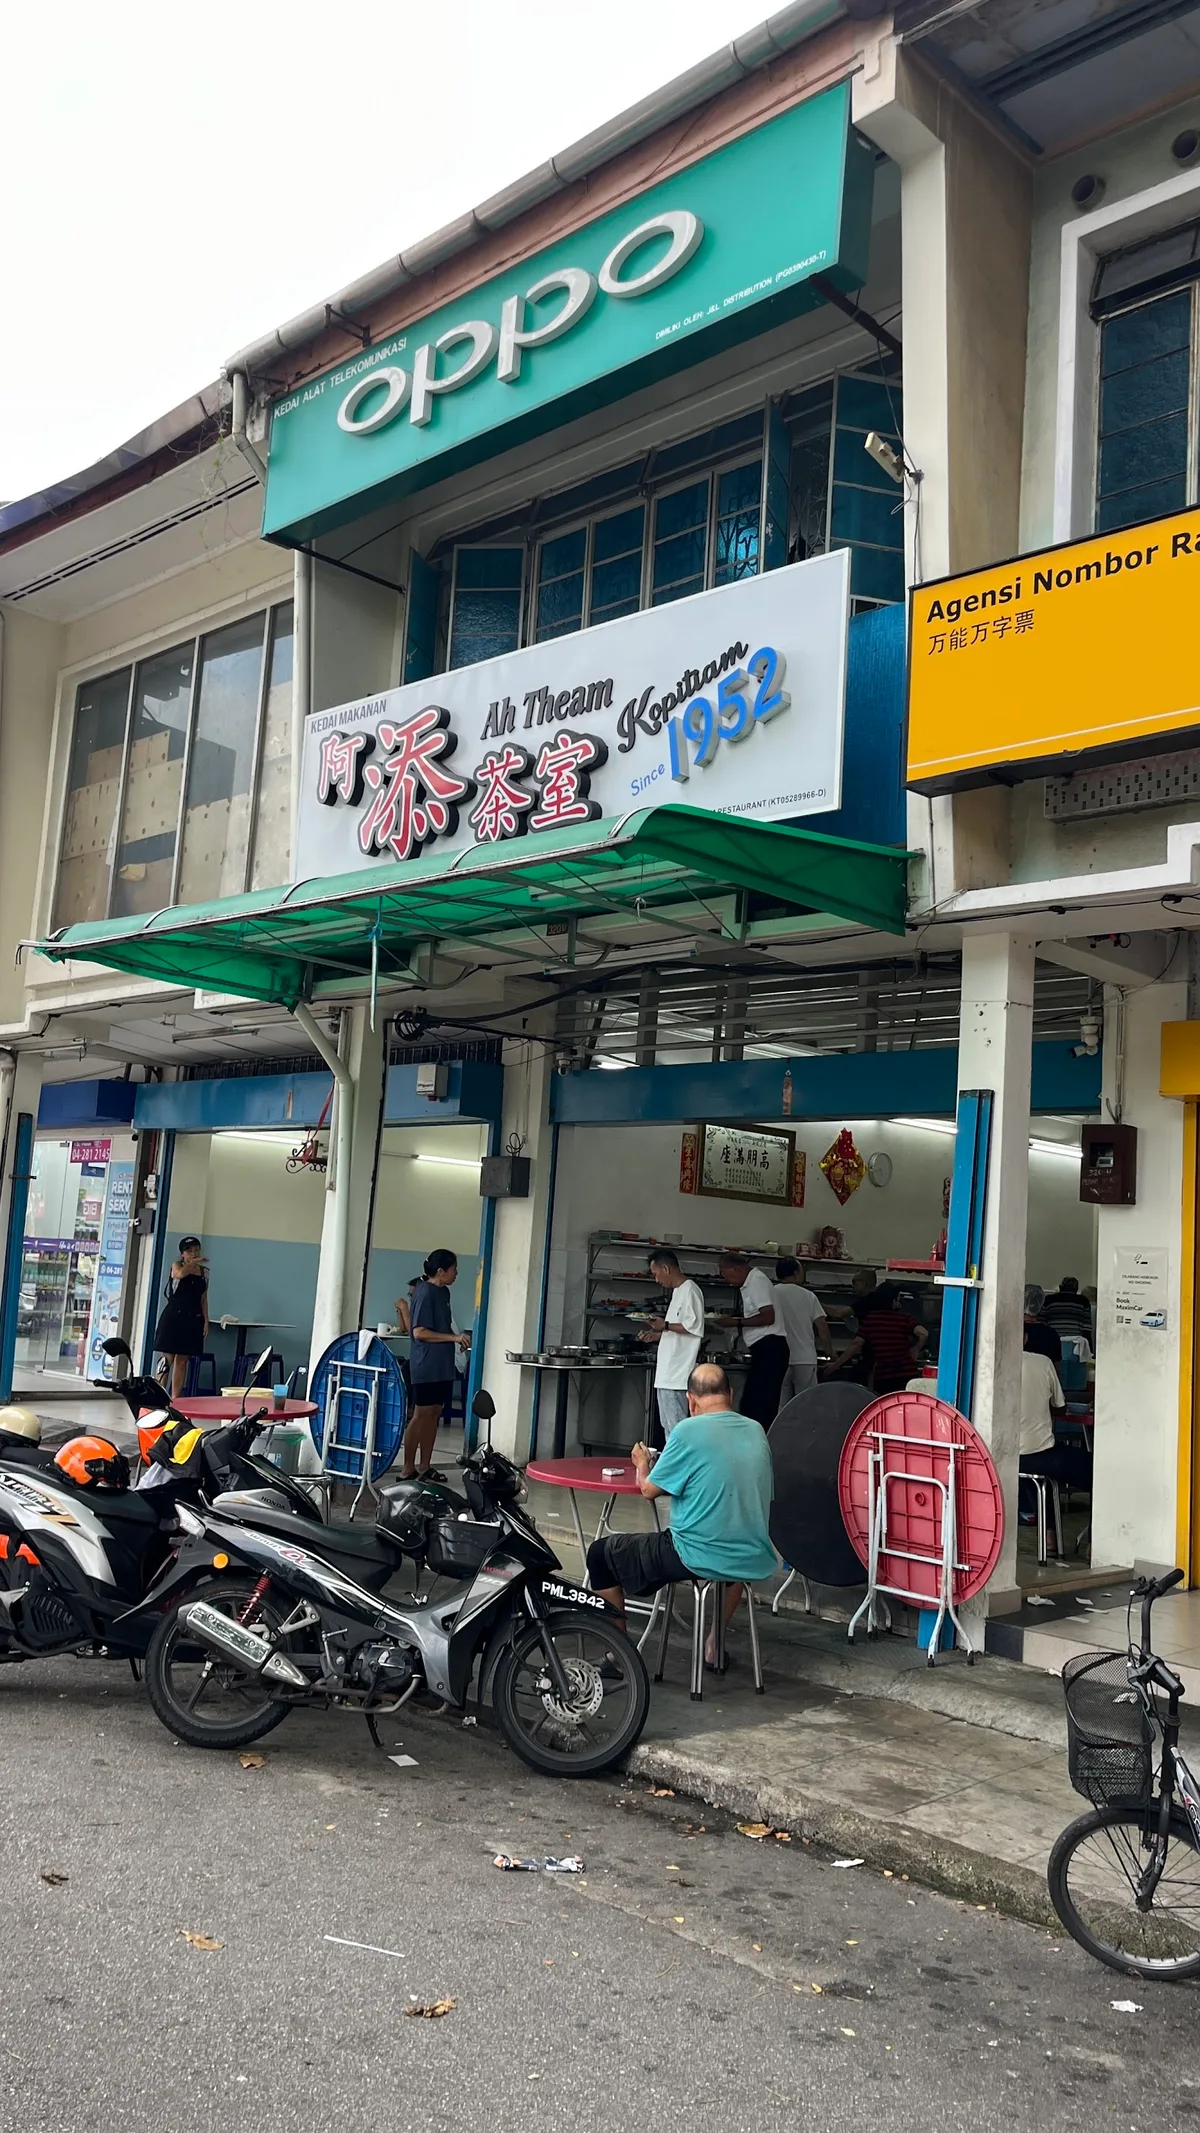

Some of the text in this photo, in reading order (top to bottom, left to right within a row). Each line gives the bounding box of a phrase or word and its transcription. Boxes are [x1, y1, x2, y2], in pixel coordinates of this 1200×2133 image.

[655, 323, 682, 340] DIMILIKI
[706, 303, 720, 315] J&L
[723, 277, 773, 307] DISTRIBUTION
[274, 337, 407, 420] KEDAI ALAT TELEKOMUNIKASI
[926, 577, 1022, 624] Agensi
[1032, 545, 1159, 595] Nombor
[927, 608, 1036, 656] 万能万字票
[311, 699, 388, 735] KEDAI MAKANAN
[480, 641, 750, 754] Ah Theam Kopitiam
[630, 645, 792, 797] Since 1952
[317, 704, 608, 862] 阿添茶室
[716, 788, 827, 815] RESTAURANT (KT05289966-D)
[72, 1148, 110, 1161] 04-281 2145
[108, 1199, 131, 1212] SERV
[260, 1495, 286, 1511] HONDA
[542, 1581, 606, 1611] PML3842
